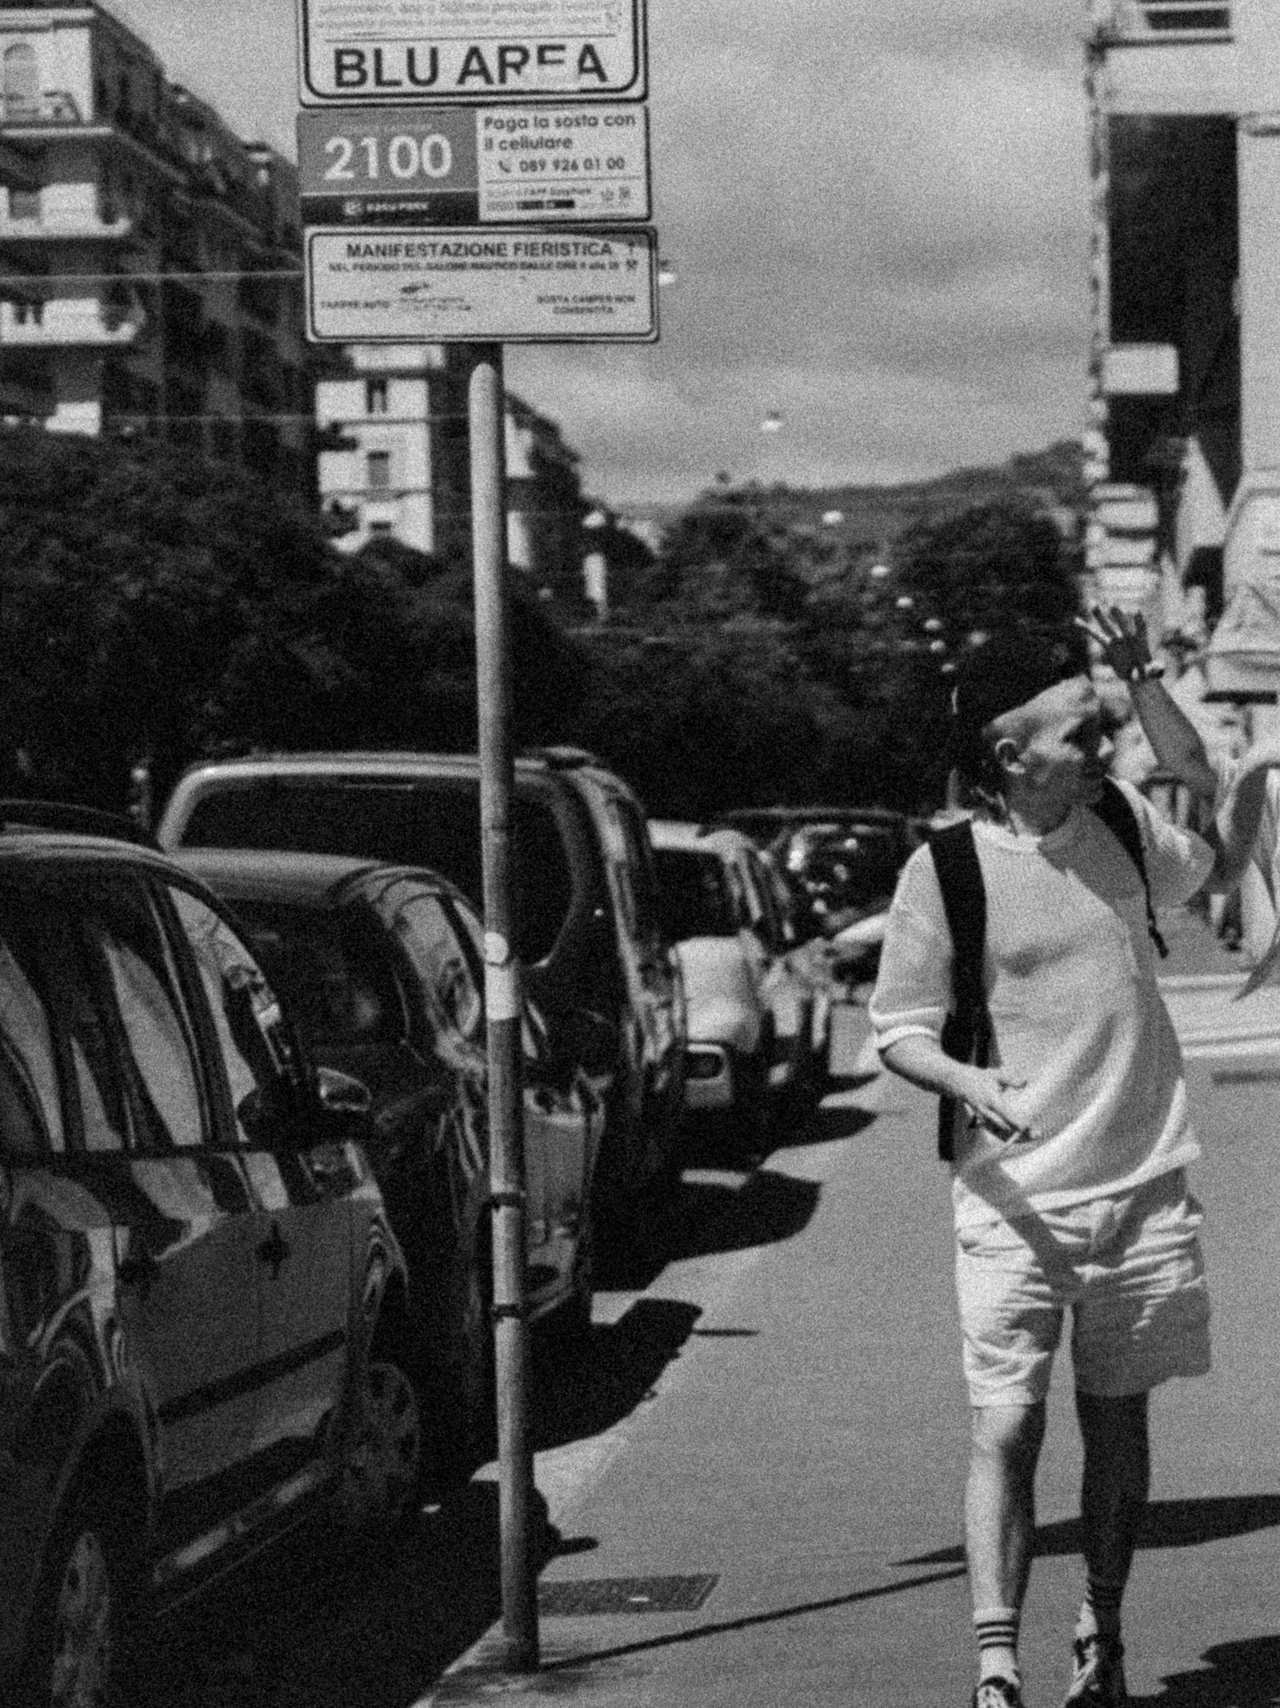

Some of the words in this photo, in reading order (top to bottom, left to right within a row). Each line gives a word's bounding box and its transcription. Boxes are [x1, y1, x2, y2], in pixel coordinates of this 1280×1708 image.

[334, 47, 438, 88] BLU
[456, 43, 609, 86] AREA
[484, 116, 529, 133] Paga
[534, 115, 550, 129] la
[554, 113, 599, 128] sosta
[603, 113, 637, 127] con
[498, 135, 574, 151] cellulare
[323, 133, 453, 181] 2100
[606, 156, 625, 170] 00
[346, 243, 508, 258] MANIFESTAZIONE
[513, 242, 613, 257] FIERISTICA
